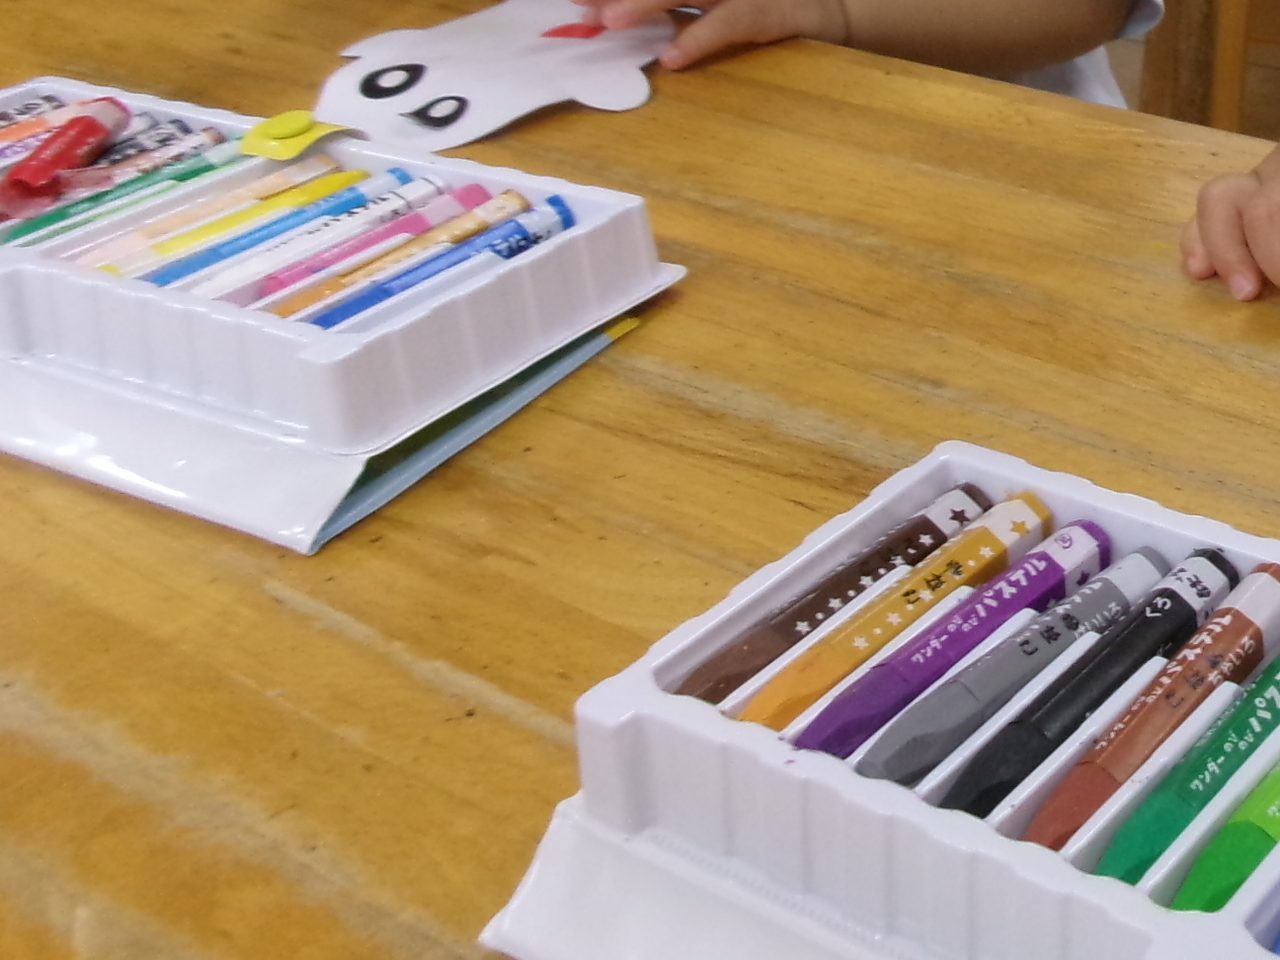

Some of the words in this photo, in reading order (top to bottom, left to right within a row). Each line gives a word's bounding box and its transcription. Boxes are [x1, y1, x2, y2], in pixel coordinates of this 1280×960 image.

[975, 559, 1048, 617] パステル
[1145, 596, 1172, 618] くろ
